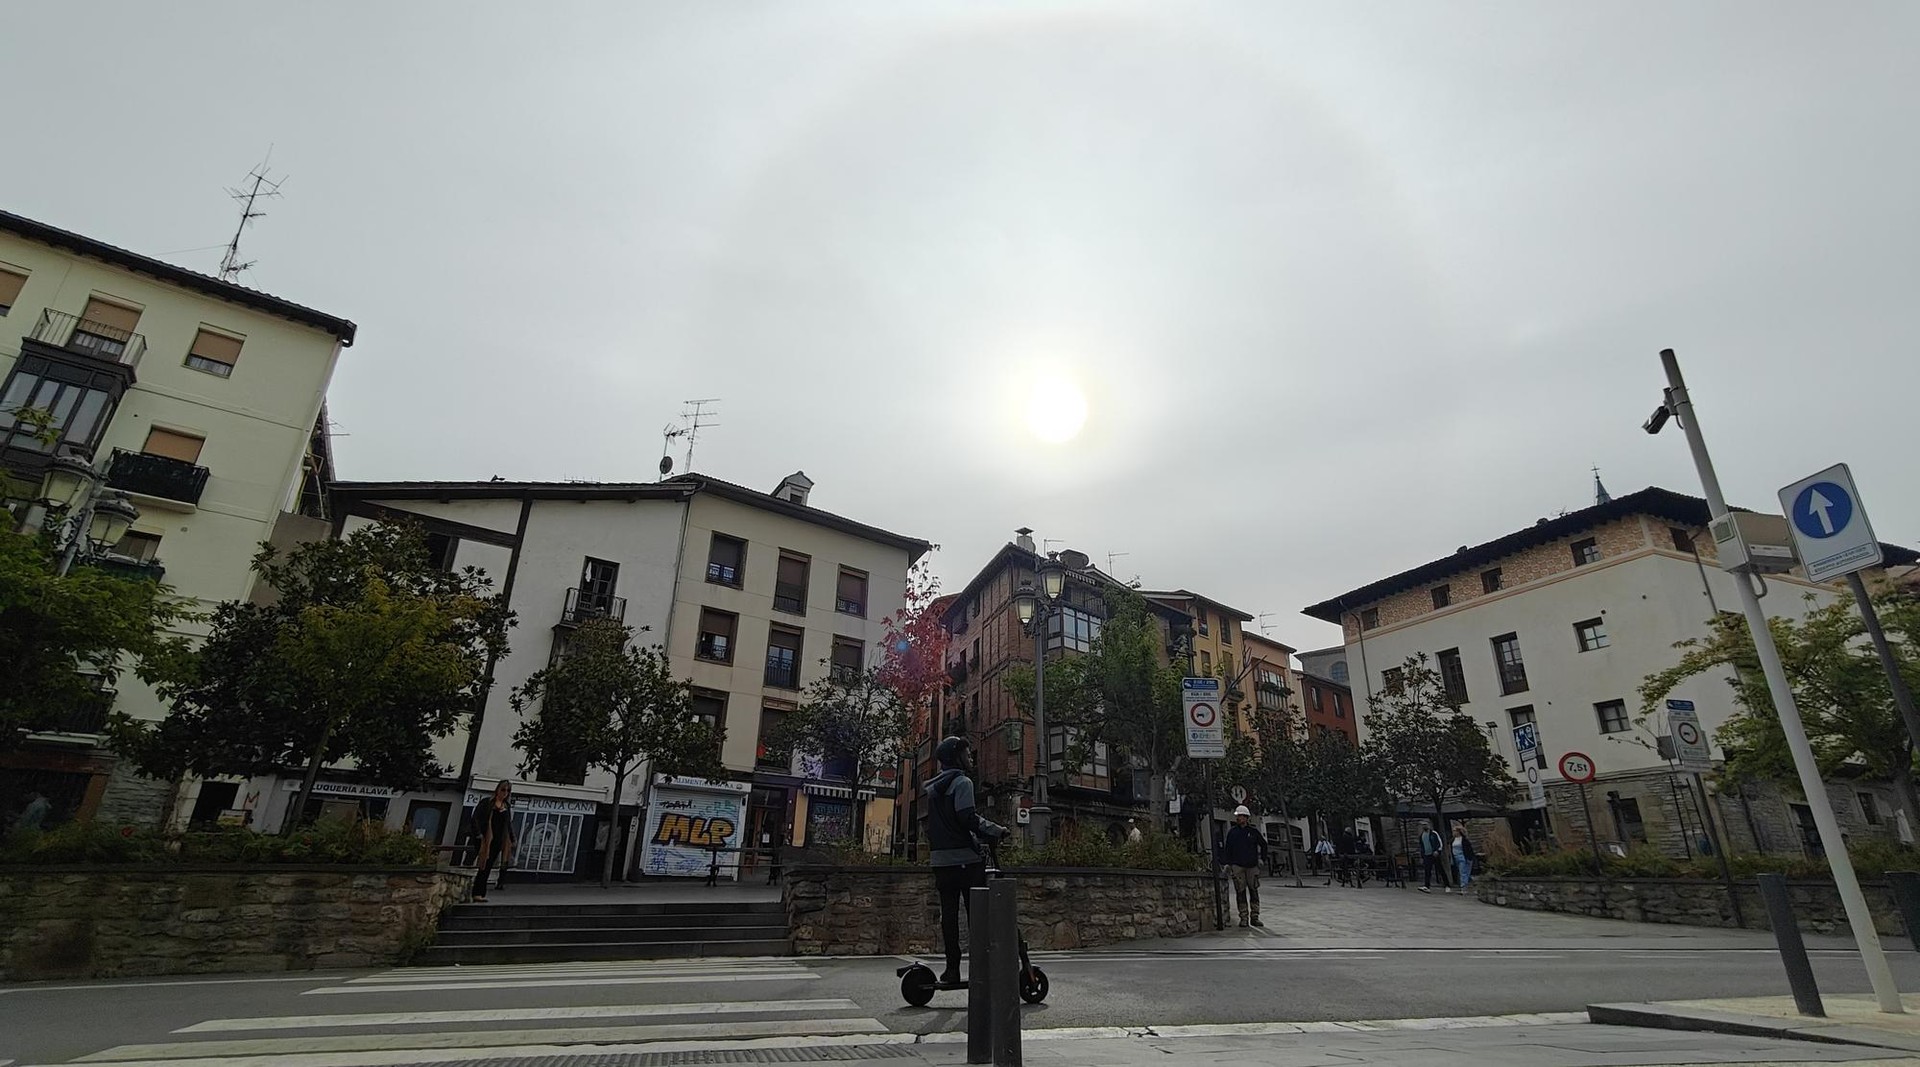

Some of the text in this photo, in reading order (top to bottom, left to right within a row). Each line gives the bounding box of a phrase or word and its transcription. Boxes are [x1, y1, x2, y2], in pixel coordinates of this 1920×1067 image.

[359, 786, 388, 795] ALAVA
[532, 799, 564, 810] PUNTA
[567, 801, 595, 812] CANA
[651, 813, 735, 847] MLP
